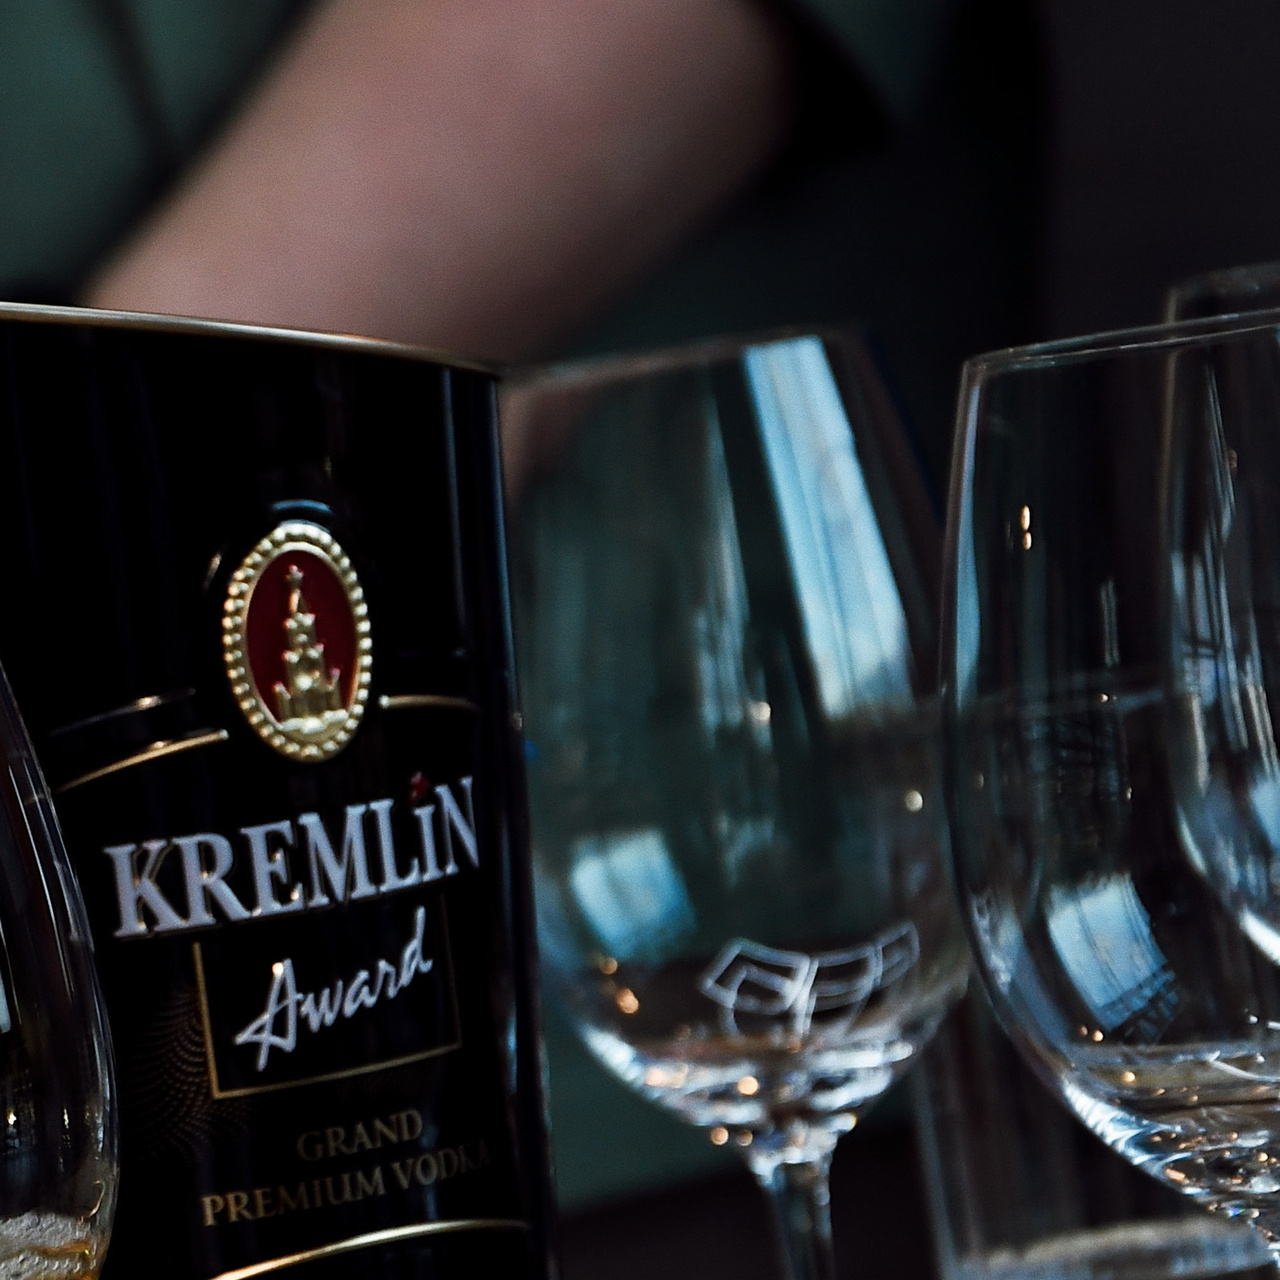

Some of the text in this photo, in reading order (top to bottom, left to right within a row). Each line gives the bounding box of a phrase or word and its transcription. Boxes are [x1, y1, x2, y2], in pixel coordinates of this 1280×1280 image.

[234, 906, 434, 1072] Award
[296, 1107, 423, 1162] GRAND
[200, 1137, 492, 1226] PREMIUM VODKA
